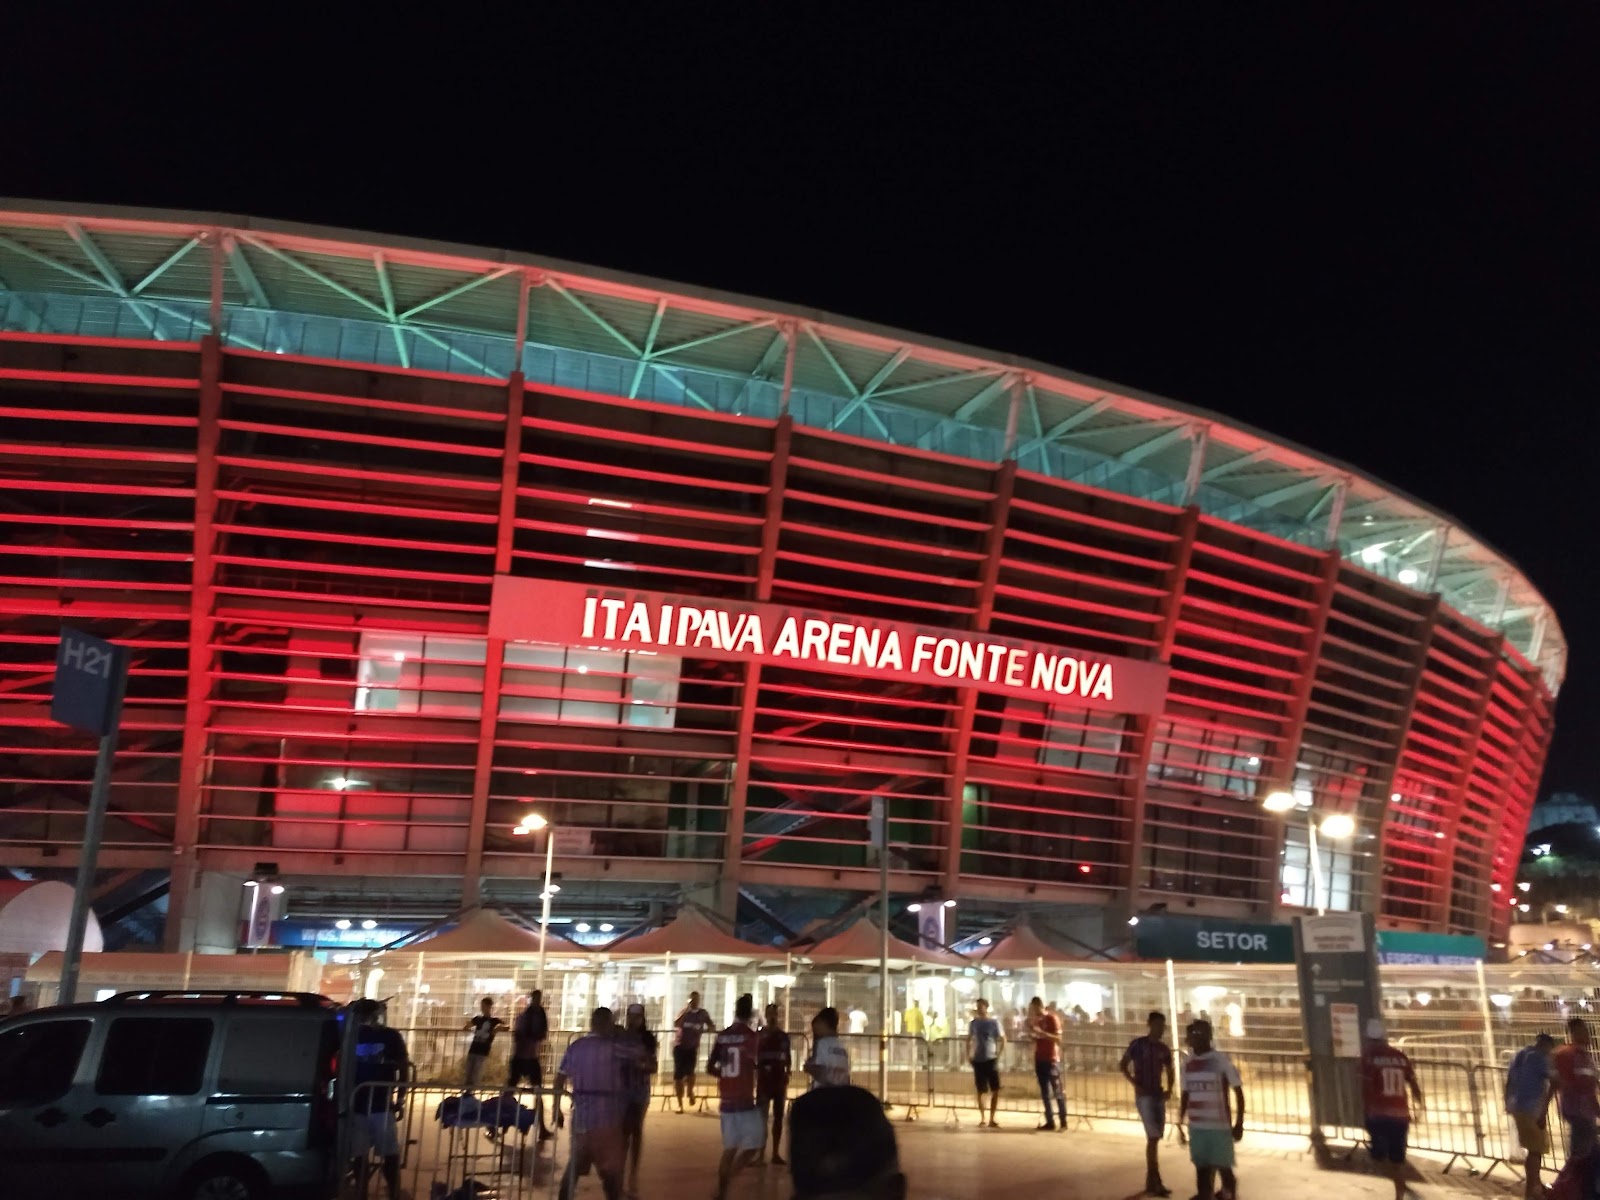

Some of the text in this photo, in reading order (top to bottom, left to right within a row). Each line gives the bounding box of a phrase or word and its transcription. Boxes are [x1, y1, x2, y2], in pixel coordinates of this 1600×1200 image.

[63, 637, 112, 679] H21
[581, 597, 1113, 700] ITAIPAVA ARENA FONTE NOVA
[1197, 931, 1268, 951] SETOR
